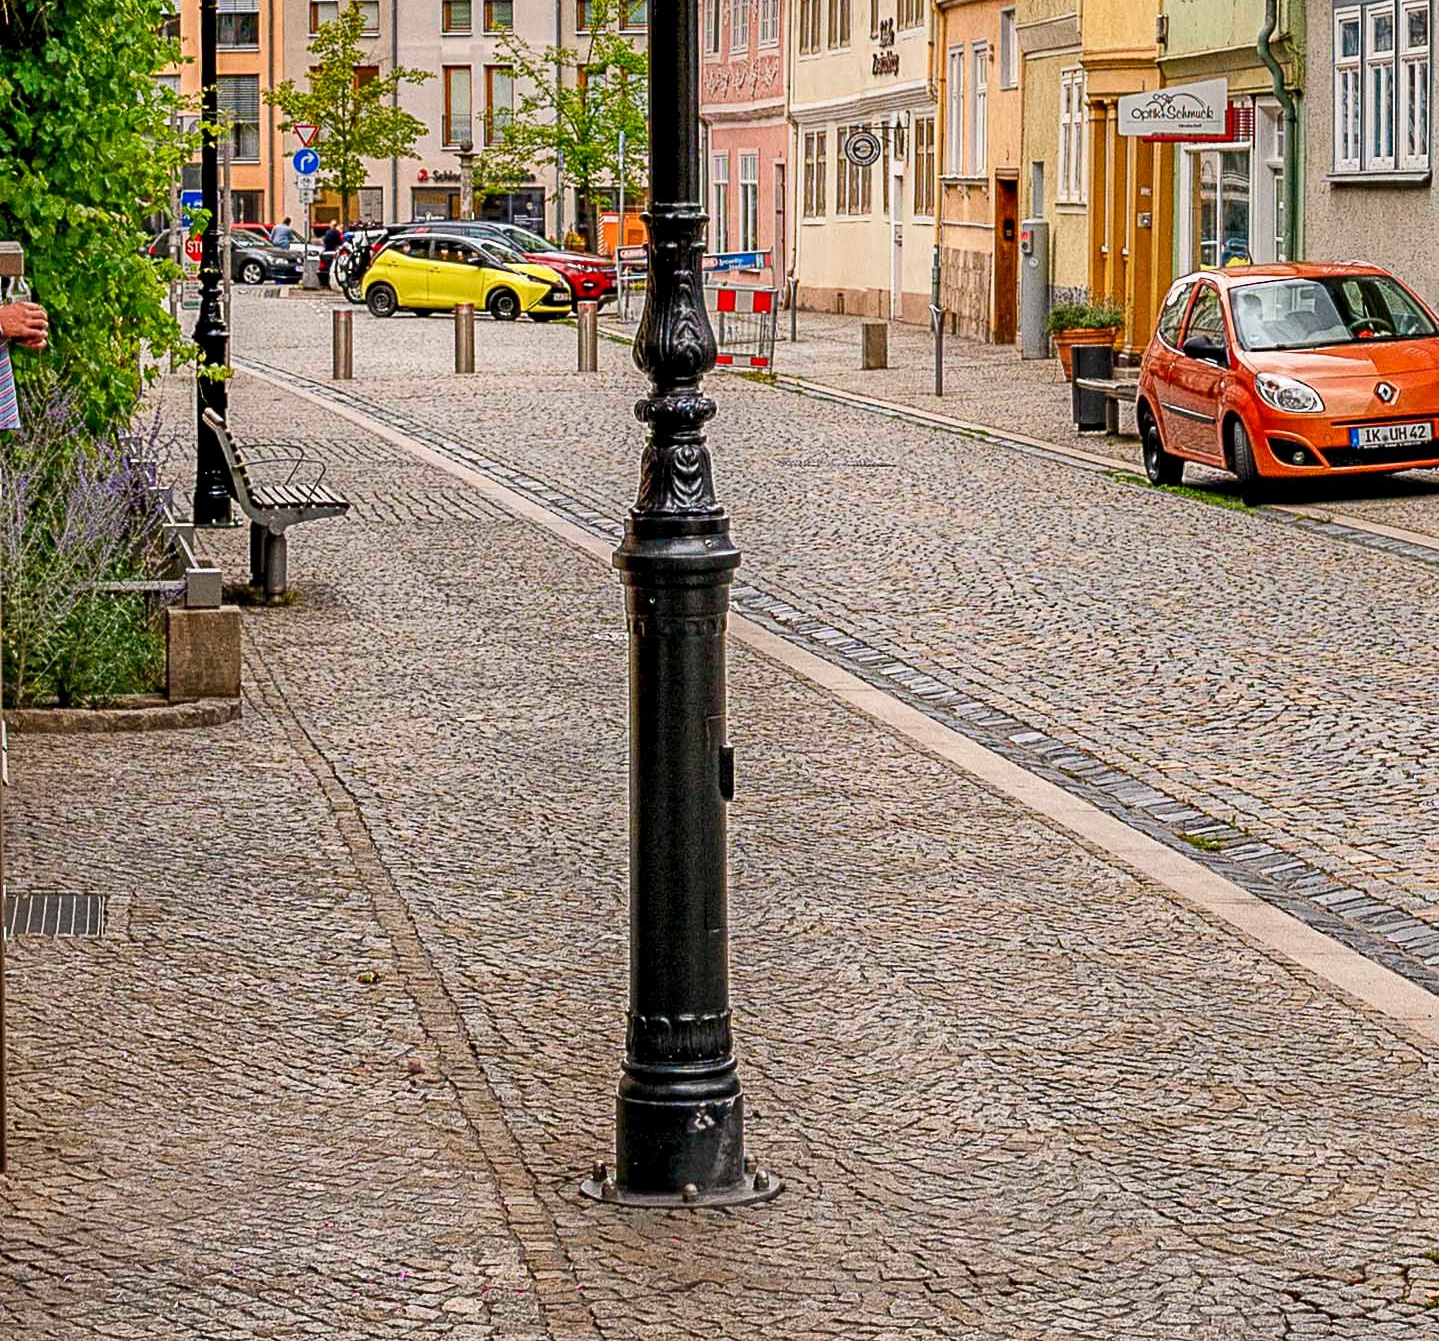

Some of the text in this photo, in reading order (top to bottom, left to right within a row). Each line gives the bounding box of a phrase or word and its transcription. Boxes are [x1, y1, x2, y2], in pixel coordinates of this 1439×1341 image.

[1365, 425, 1426, 442] IK UH 42
